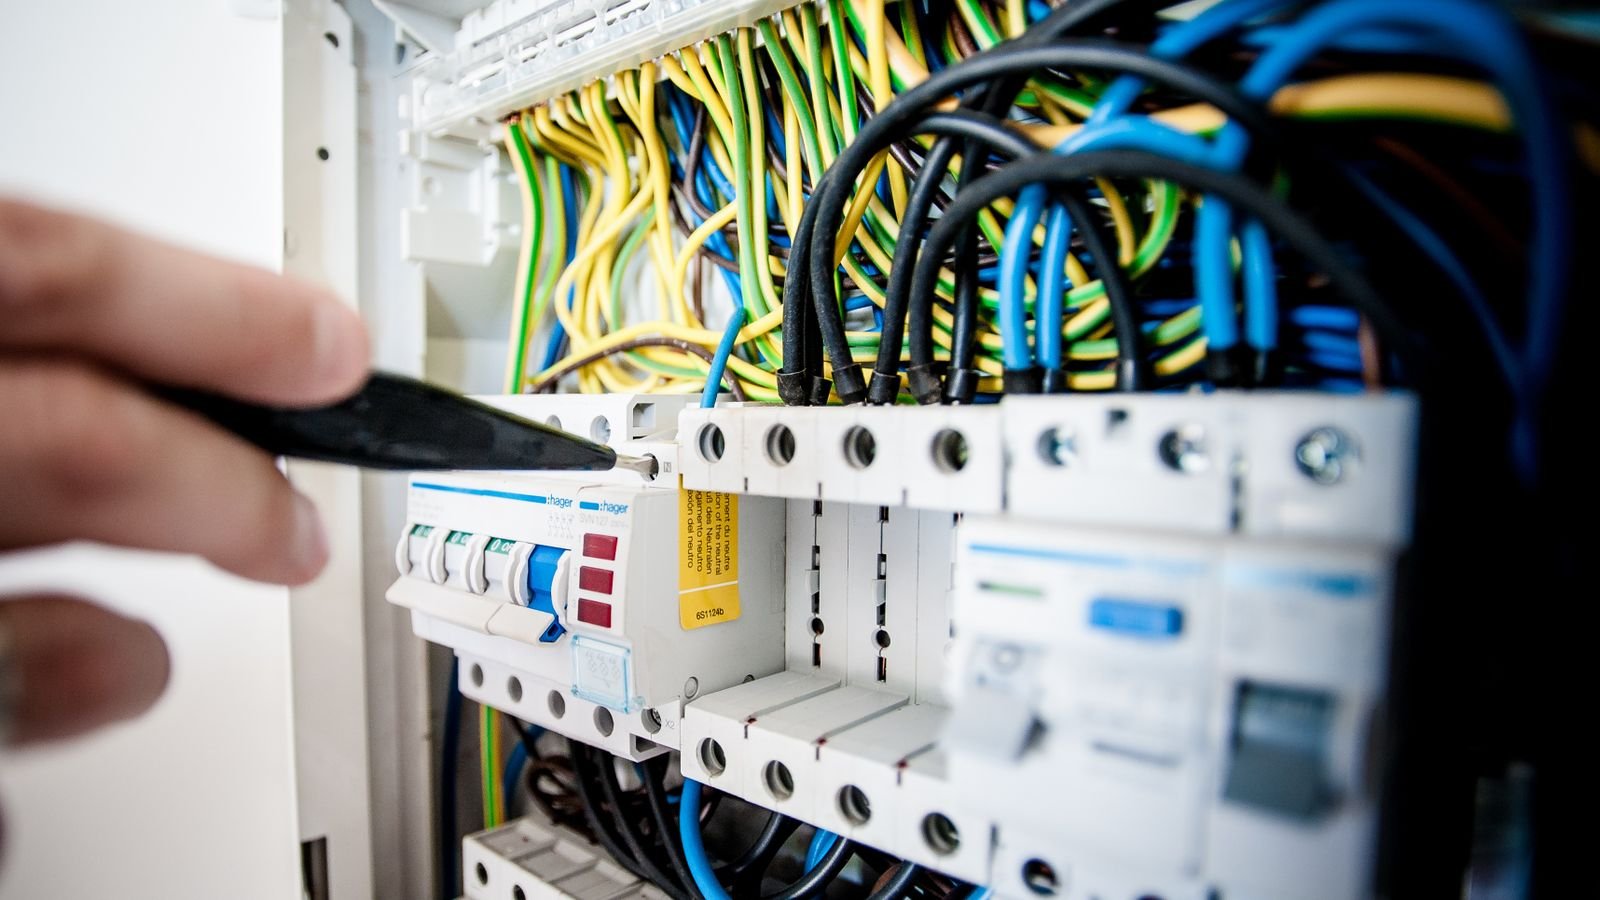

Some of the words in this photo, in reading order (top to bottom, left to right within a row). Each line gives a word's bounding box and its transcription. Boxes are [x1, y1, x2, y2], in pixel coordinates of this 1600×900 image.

[715, 512, 722, 521] of
[724, 525, 731, 537] du
[696, 607, 725, 620] 6S1124b
